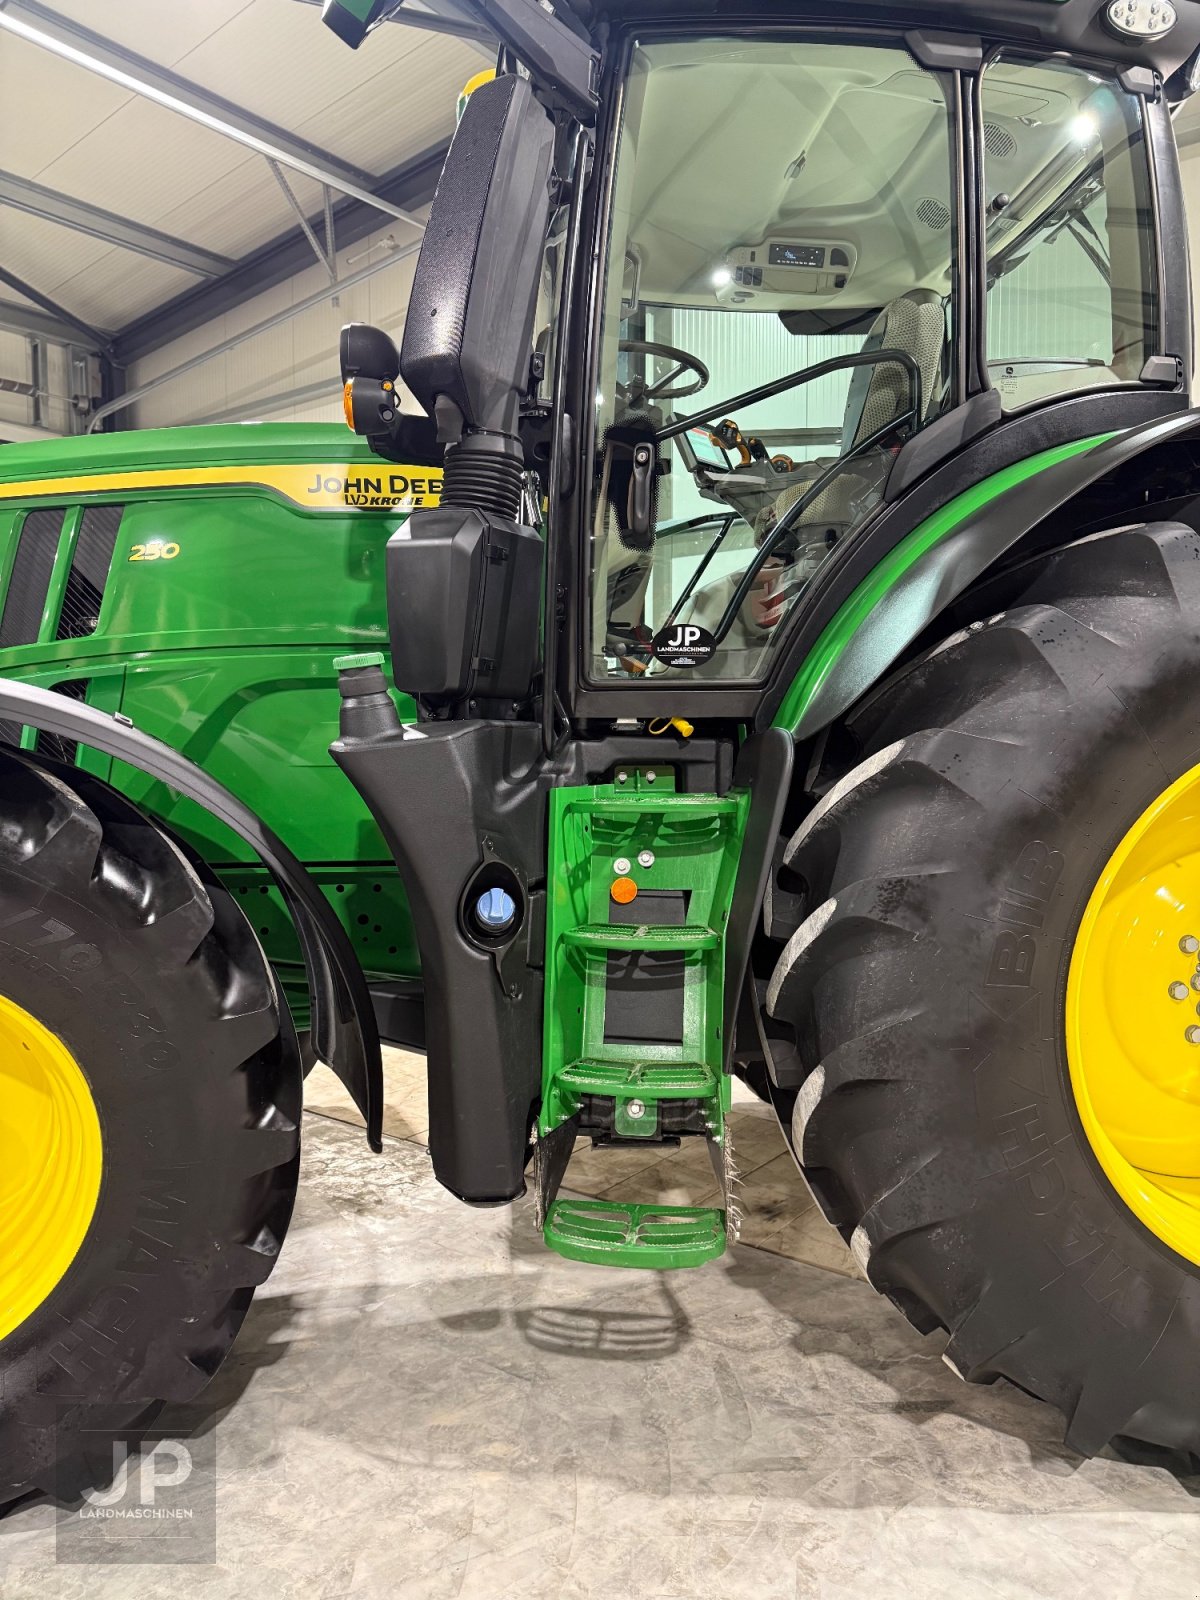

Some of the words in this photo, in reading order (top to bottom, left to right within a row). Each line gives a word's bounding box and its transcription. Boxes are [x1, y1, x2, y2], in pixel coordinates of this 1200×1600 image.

[307, 474, 382, 494] JOHN
[389, 475, 443, 495] DEE
[344, 494, 367, 506] LVD
[127, 542, 181, 562] 250
[667, 626, 701, 647] JP
